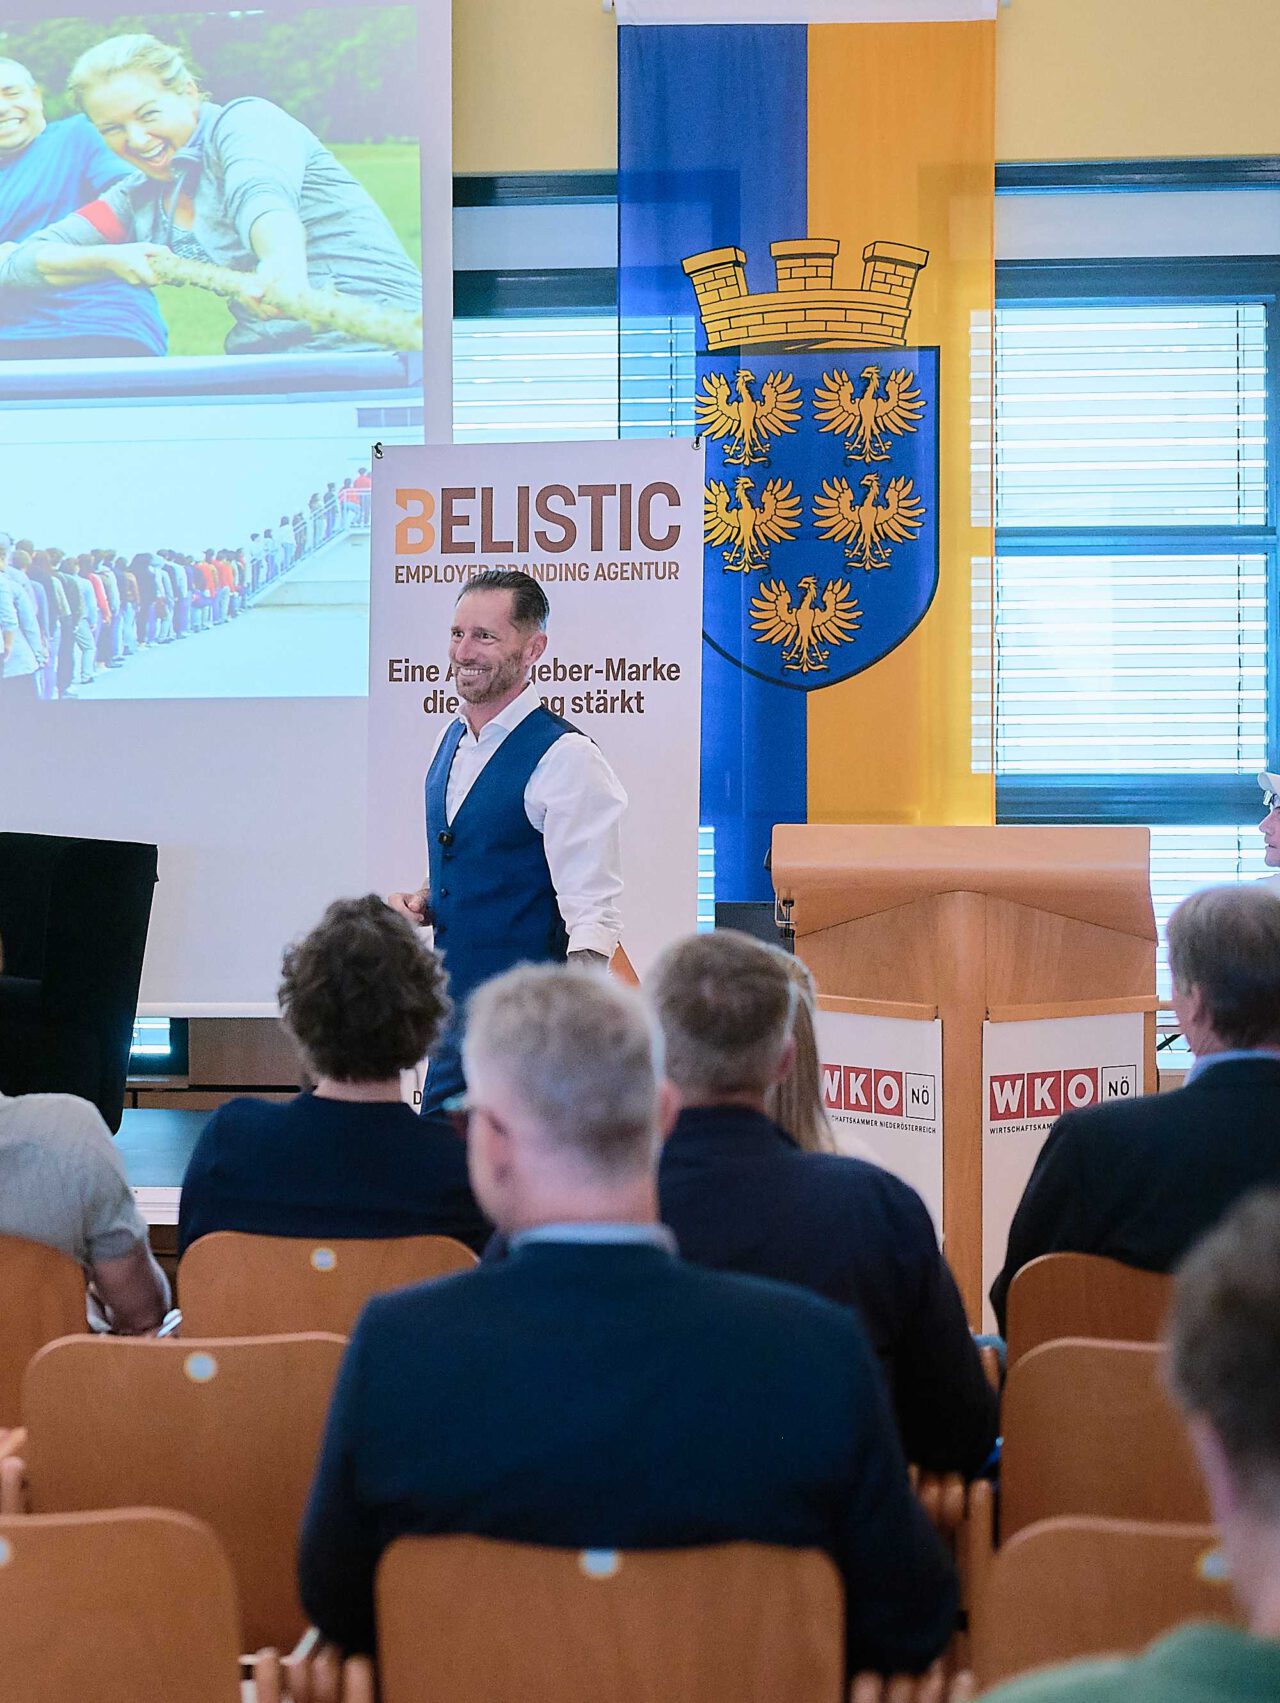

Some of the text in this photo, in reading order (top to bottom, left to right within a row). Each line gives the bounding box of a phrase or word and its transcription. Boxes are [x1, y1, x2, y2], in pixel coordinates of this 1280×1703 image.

[395, 482, 681, 555] BELISTIC
[594, 561, 679, 581] AGENTUR
[388, 659, 440, 682] Eine
[424, 690, 459, 714] die
[571, 690, 645, 714] stärkt
[820, 1070, 930, 1110] WKO NÖ
[992, 1074, 1130, 1114] WKO NÖ
[880, 1121, 936, 1134] NIEDERÖSTERREICH
[990, 1122, 1056, 1134] WIRTSCHAFTSKAM
